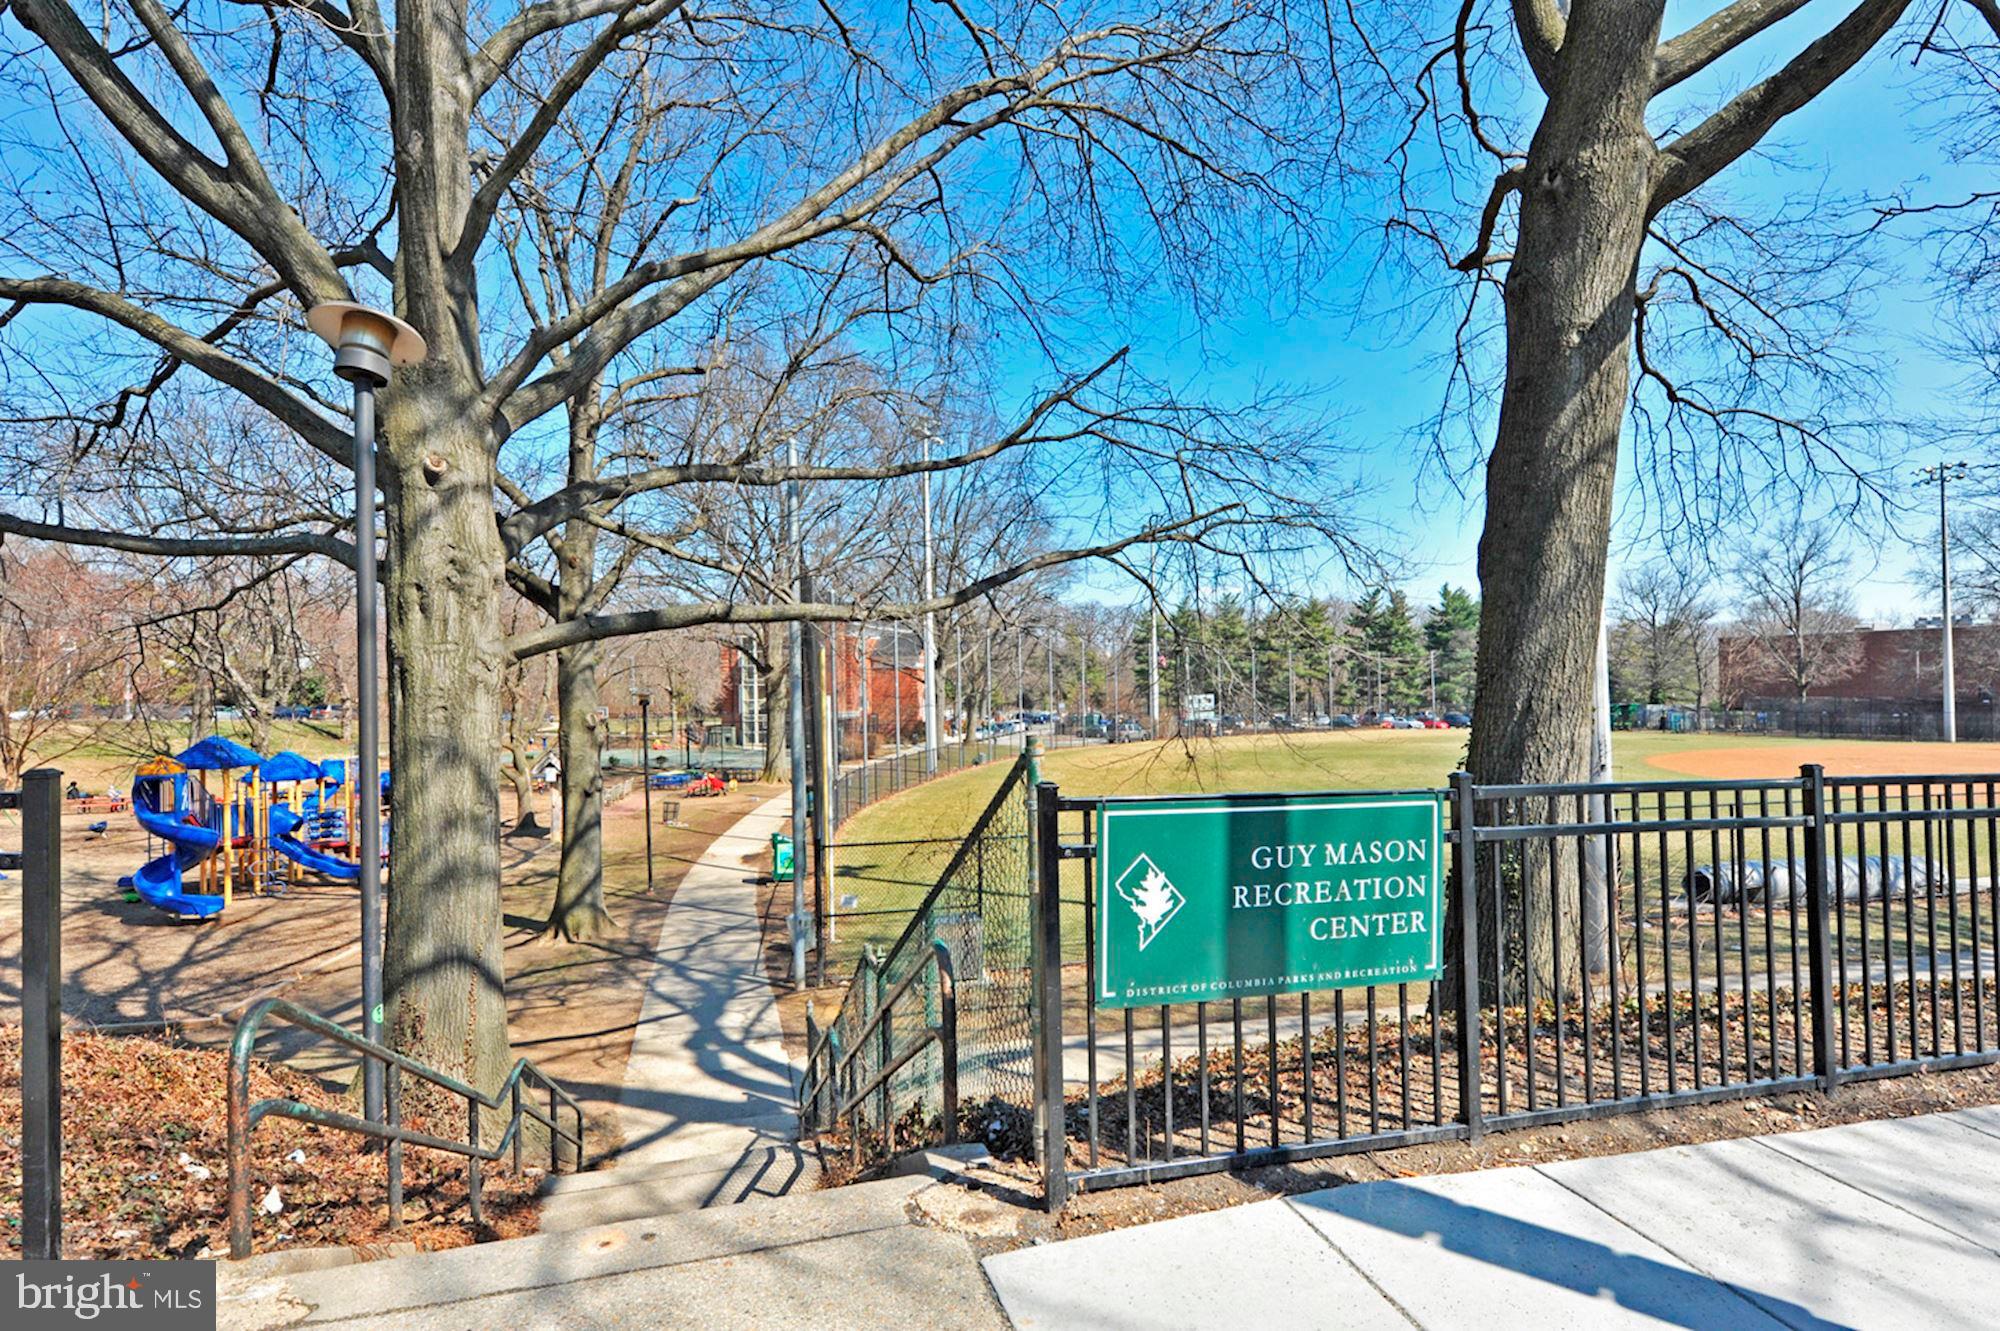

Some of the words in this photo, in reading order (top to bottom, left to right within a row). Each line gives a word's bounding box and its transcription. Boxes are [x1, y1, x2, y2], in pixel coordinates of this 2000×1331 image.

[1251, 844, 1317, 870] GUY
[1324, 839, 1427, 866] MASON
[1232, 875, 1427, 909] RECREATION
[1310, 911, 1427, 941] CENTER
[1126, 984, 1188, 998] DISTRICT
[1191, 982, 1208, 993] OF
[1210, 978, 1275, 991] COLUMBIA
[1278, 973, 1315, 985] PARKS
[1317, 970, 1342, 982] AND
[1344, 964, 1418, 979] RECREATION
